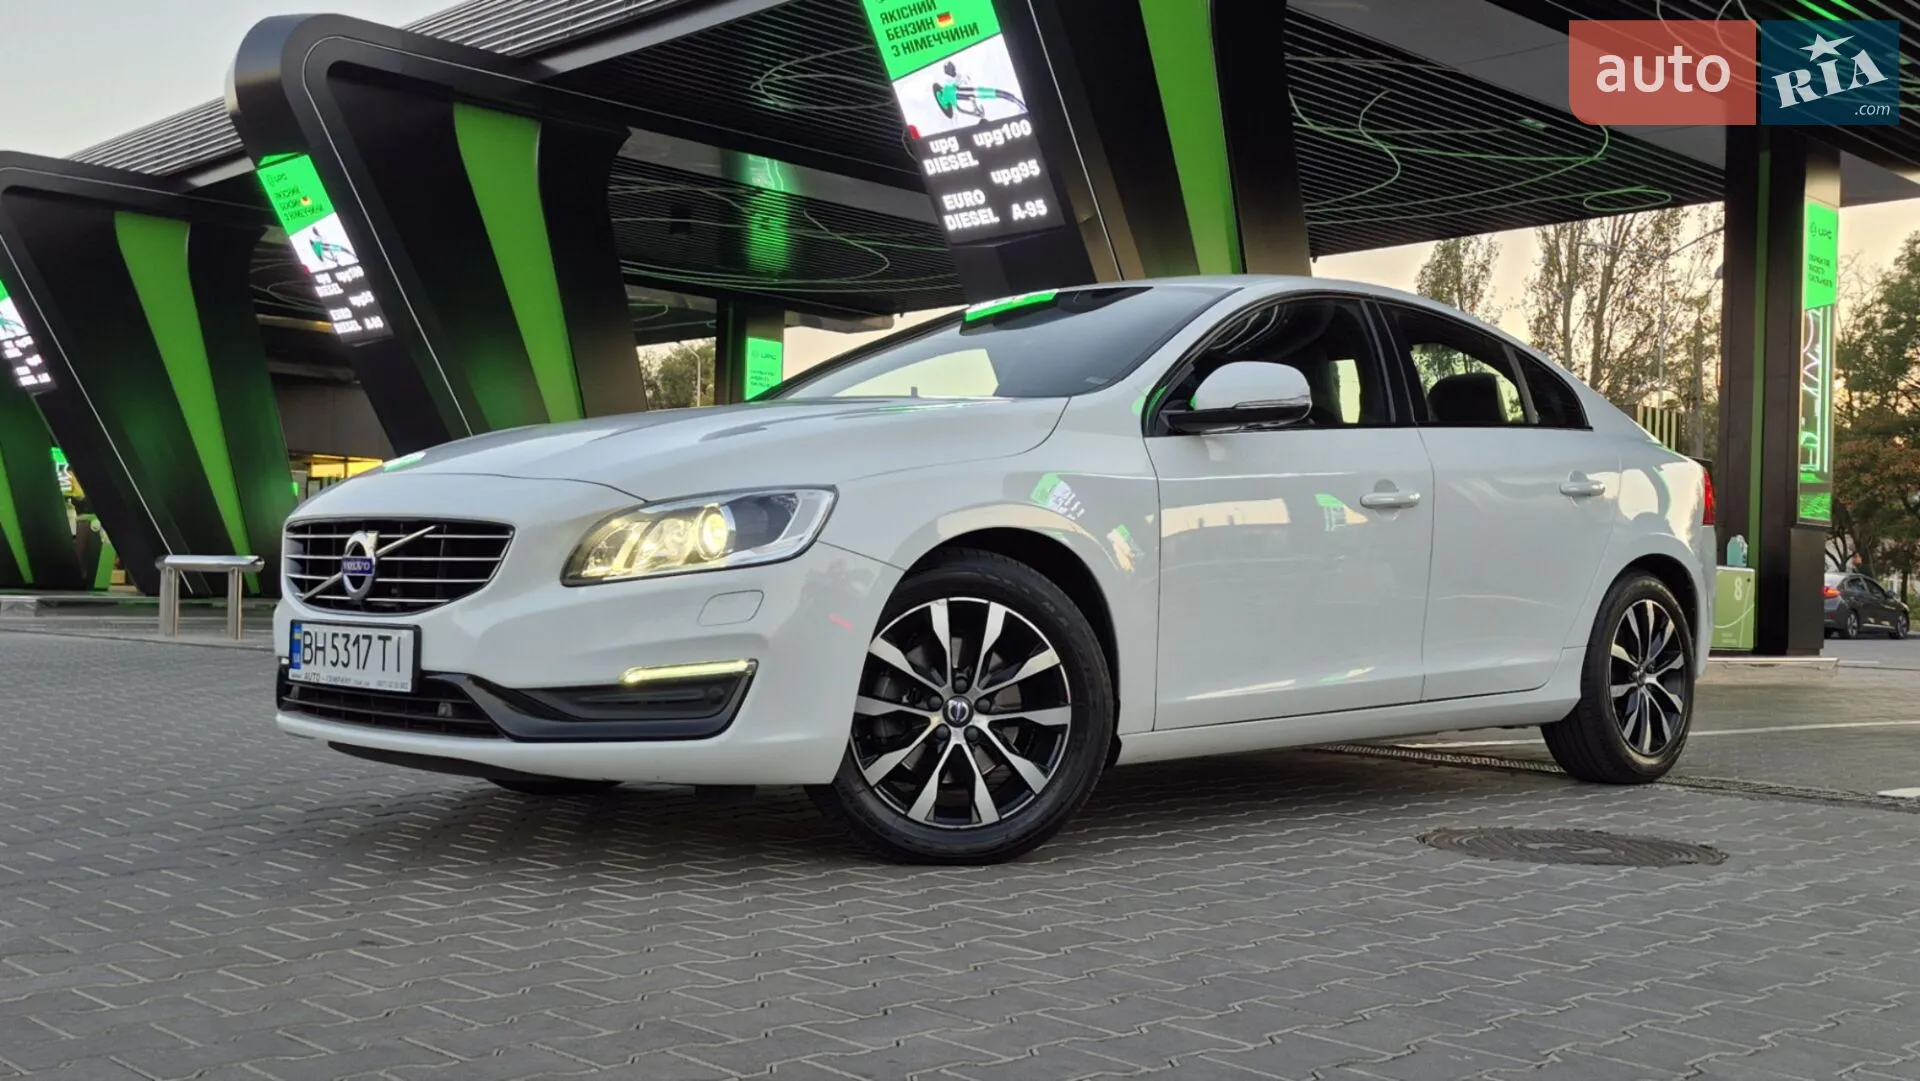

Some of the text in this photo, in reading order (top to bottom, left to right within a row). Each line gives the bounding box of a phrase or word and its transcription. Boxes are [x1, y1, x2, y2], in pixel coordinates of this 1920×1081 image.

[885, 17, 936, 41] БЕНЗИН
[890, 22, 980, 57] З НІМЕЧЧИНИ
[929, 119, 1033, 154] upg upg100
[923, 150, 980, 176] DIESEL
[990, 159, 1041, 186] upg95
[942, 189, 986, 211] EURO
[943, 199, 1048, 231] DIESEL A-95
[344, 560, 371, 571] VOLVO
[1734, 576, 1742, 601] 8
[302, 631, 327, 667] BH
[330, 632, 373, 671] 5317
